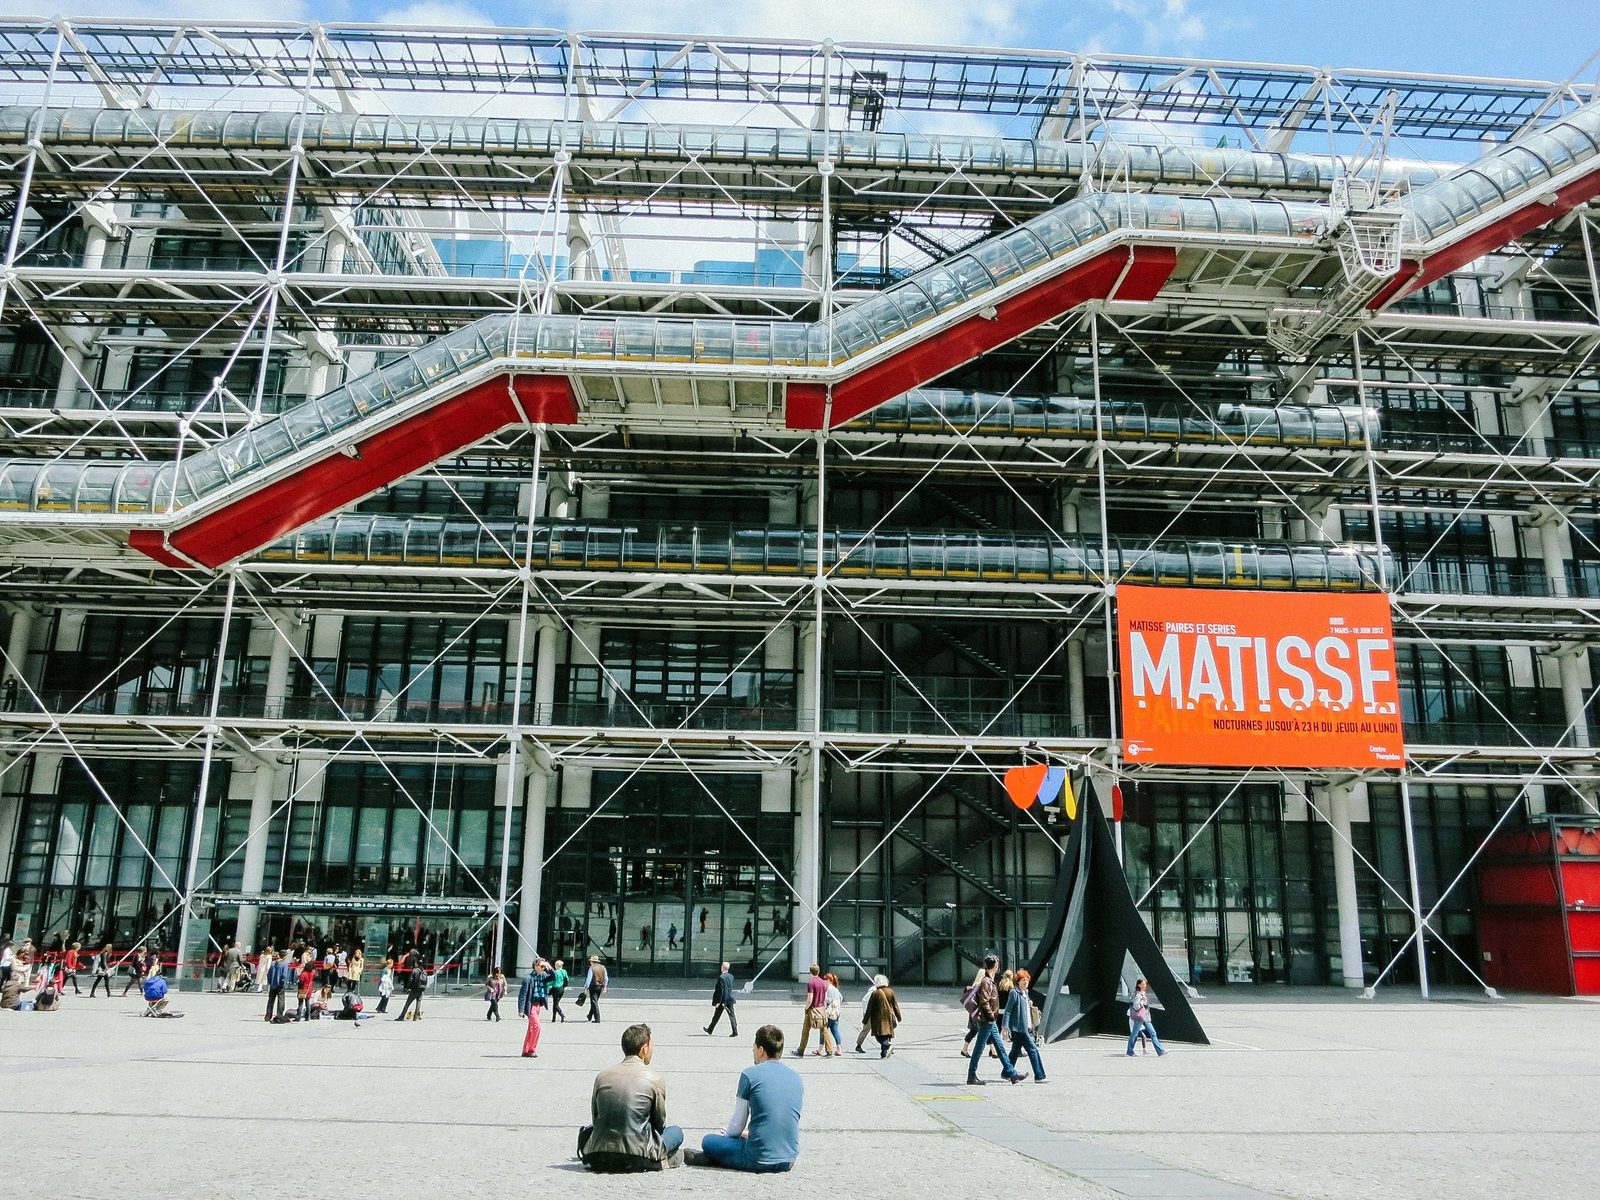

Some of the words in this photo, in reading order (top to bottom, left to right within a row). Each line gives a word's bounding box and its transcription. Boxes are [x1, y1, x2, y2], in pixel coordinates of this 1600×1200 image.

[1129, 620, 1164, 632] MATISSE
[1165, 621, 1194, 634] PAIRES
[1196, 623, 1206, 634] ET
[1129, 631, 1396, 714] MATISSE
[1213, 719, 1263, 732] NOCTURNES
[1265, 718, 1300, 732] JUSQU'À
[1301, 721, 1312, 732] 23
[1313, 721, 1319, 732] H
[1321, 721, 1333, 733] DU
[1335, 722, 1359, 734] JEUDI
[1360, 722, 1372, 733] AU
[1373, 723, 1398, 734] LUNDI
[1369, 745, 1387, 753] Centre
